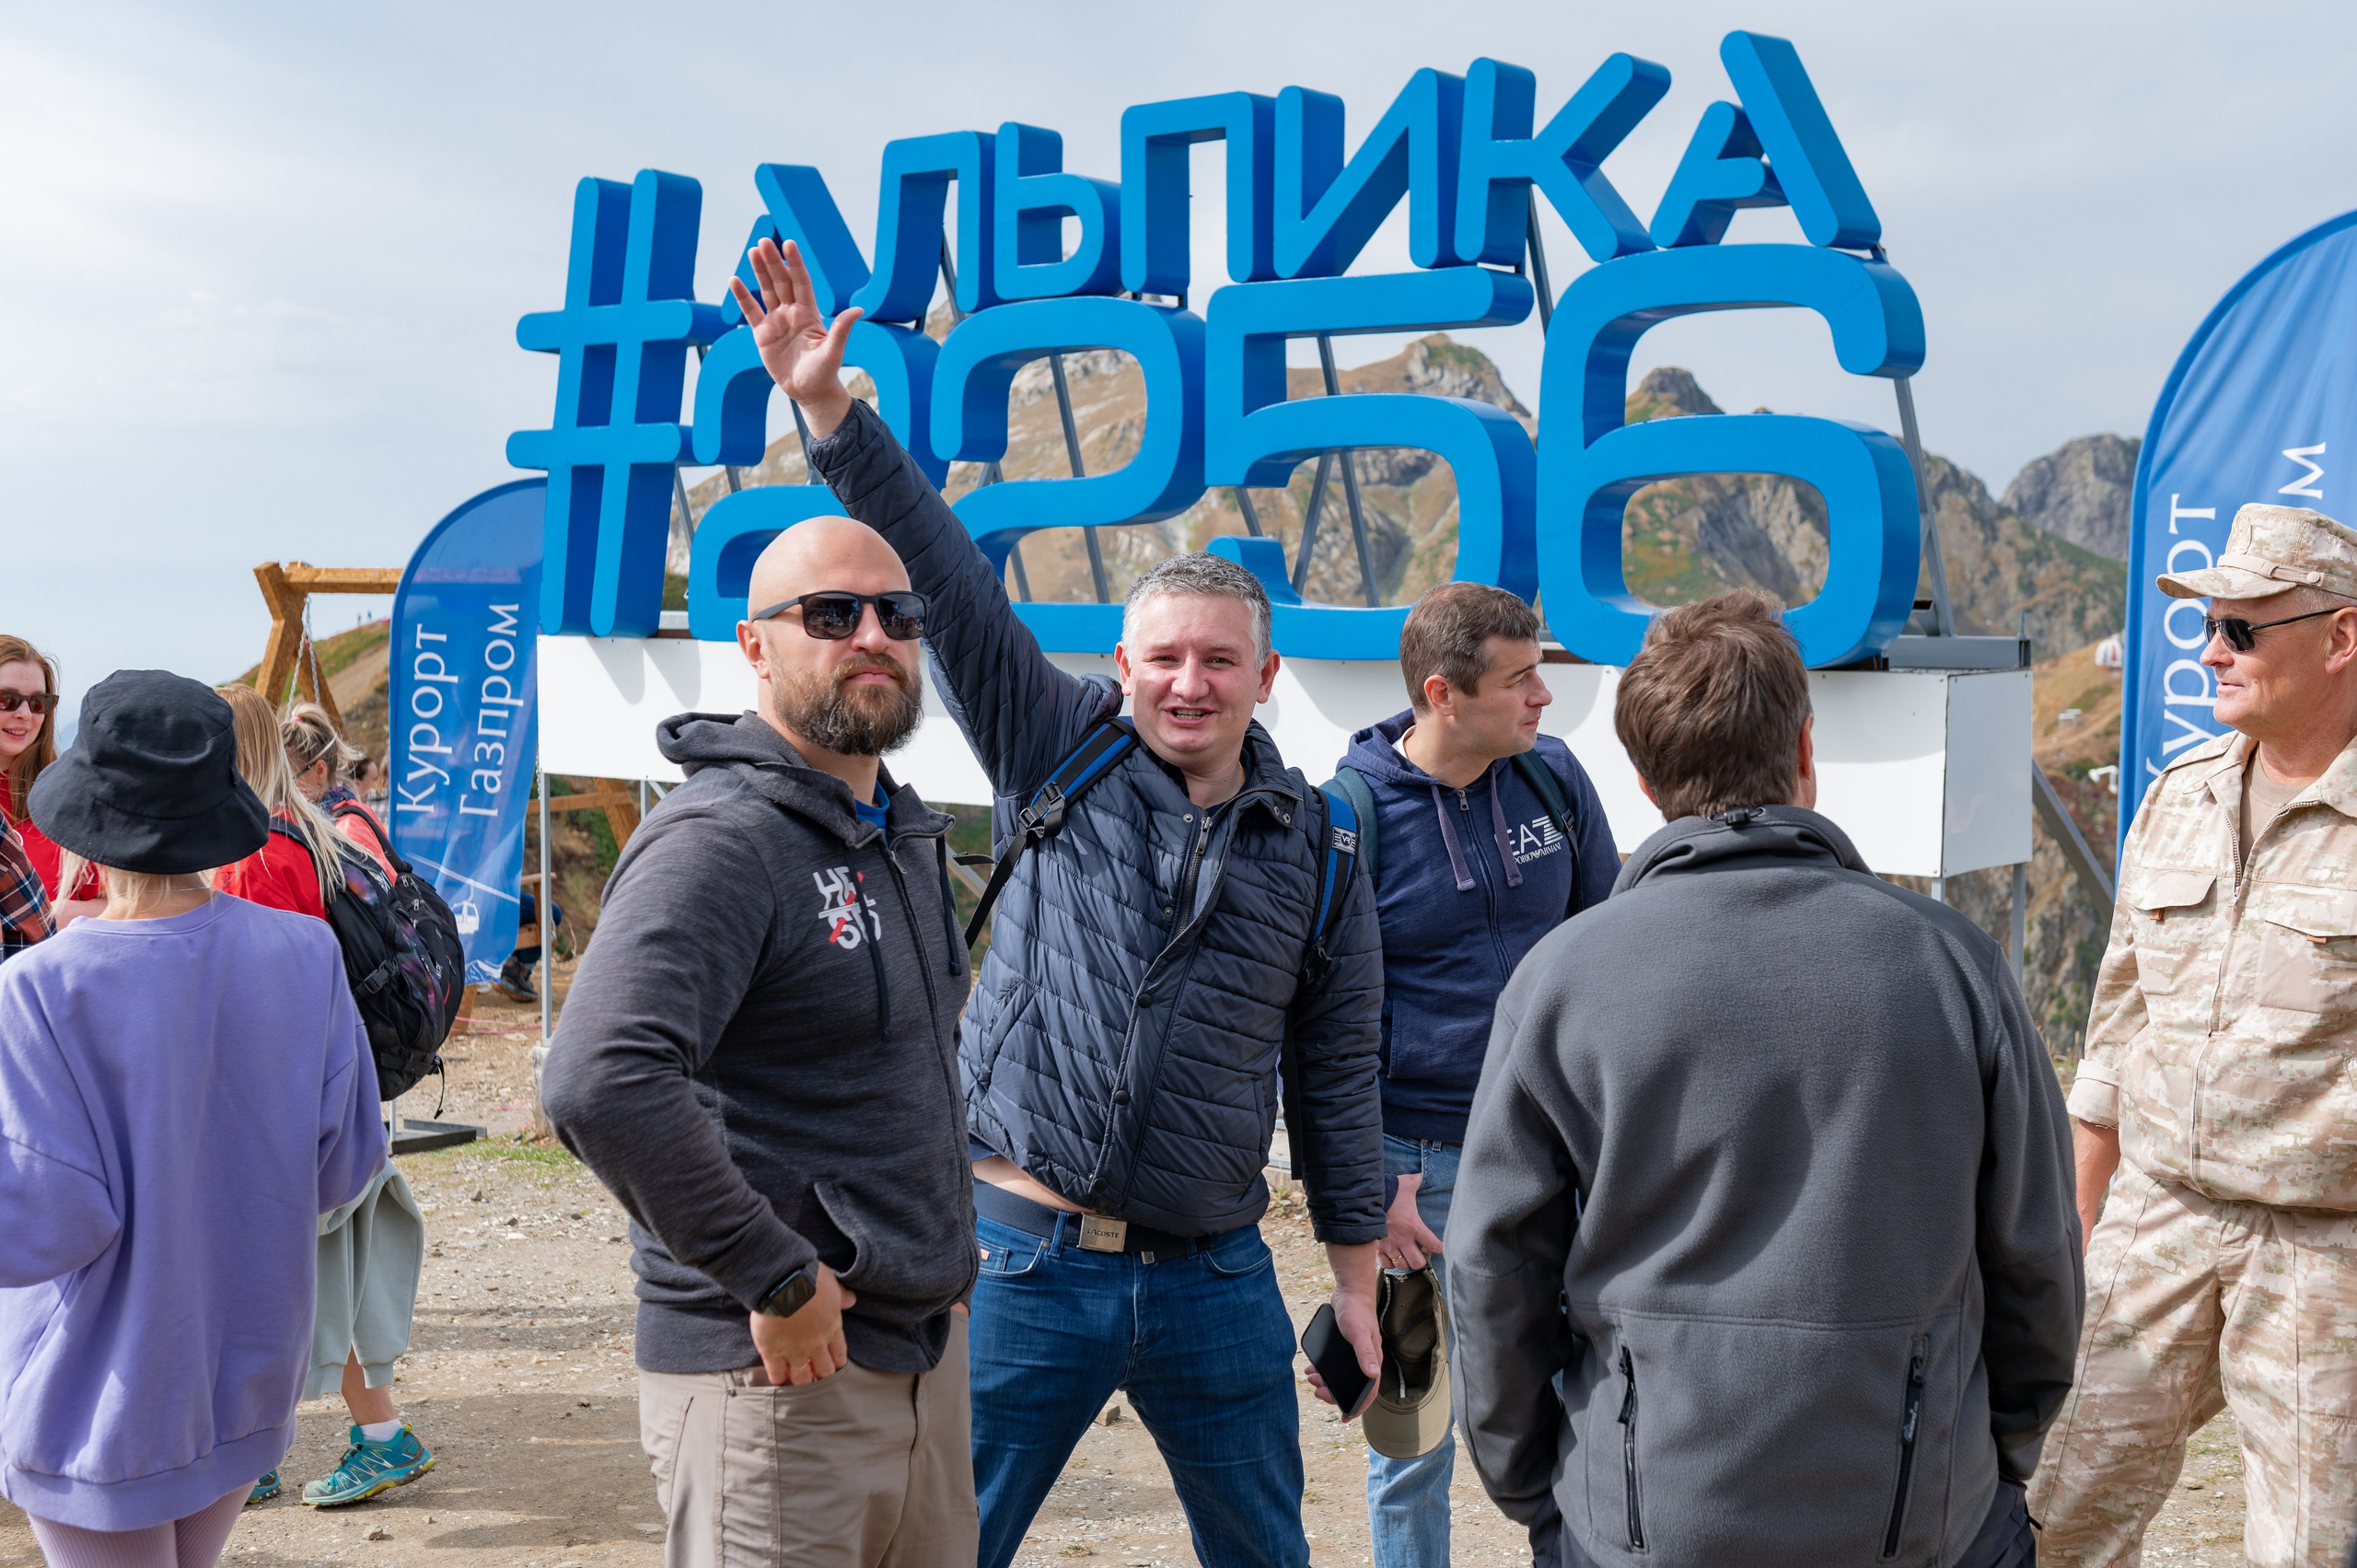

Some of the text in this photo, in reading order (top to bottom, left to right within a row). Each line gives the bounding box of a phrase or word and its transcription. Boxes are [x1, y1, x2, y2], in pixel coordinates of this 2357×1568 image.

[396, 623, 459, 812] Курорт
[459, 603, 524, 817] Газпром
[1087, 1228, 1120, 1239] LACOSTE
